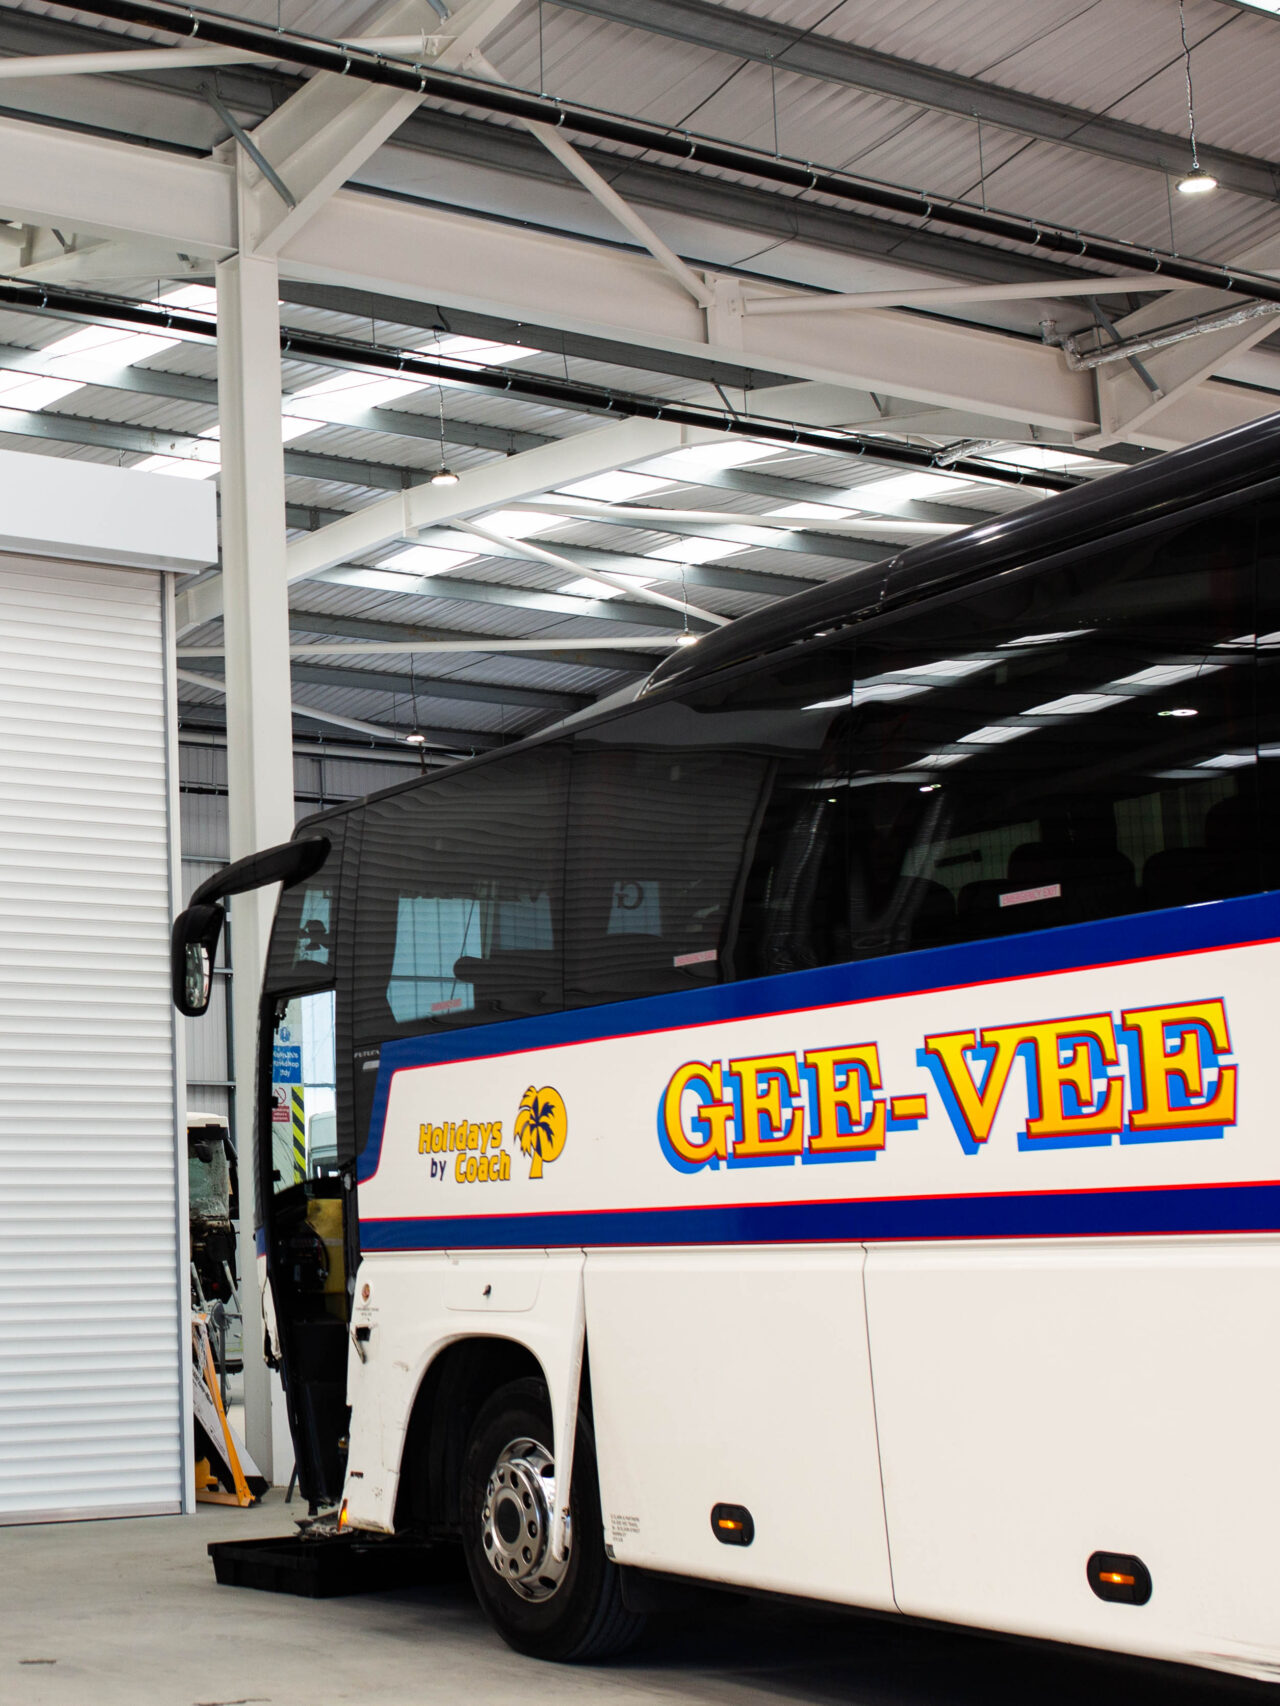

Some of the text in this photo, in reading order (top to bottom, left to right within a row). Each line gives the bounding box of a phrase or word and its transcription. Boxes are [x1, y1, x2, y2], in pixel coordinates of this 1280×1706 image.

[656, 996, 1239, 1175] GEE-VEE
[418, 1119, 502, 1154] Holidays
[430, 1149, 511, 1183] by Coach
